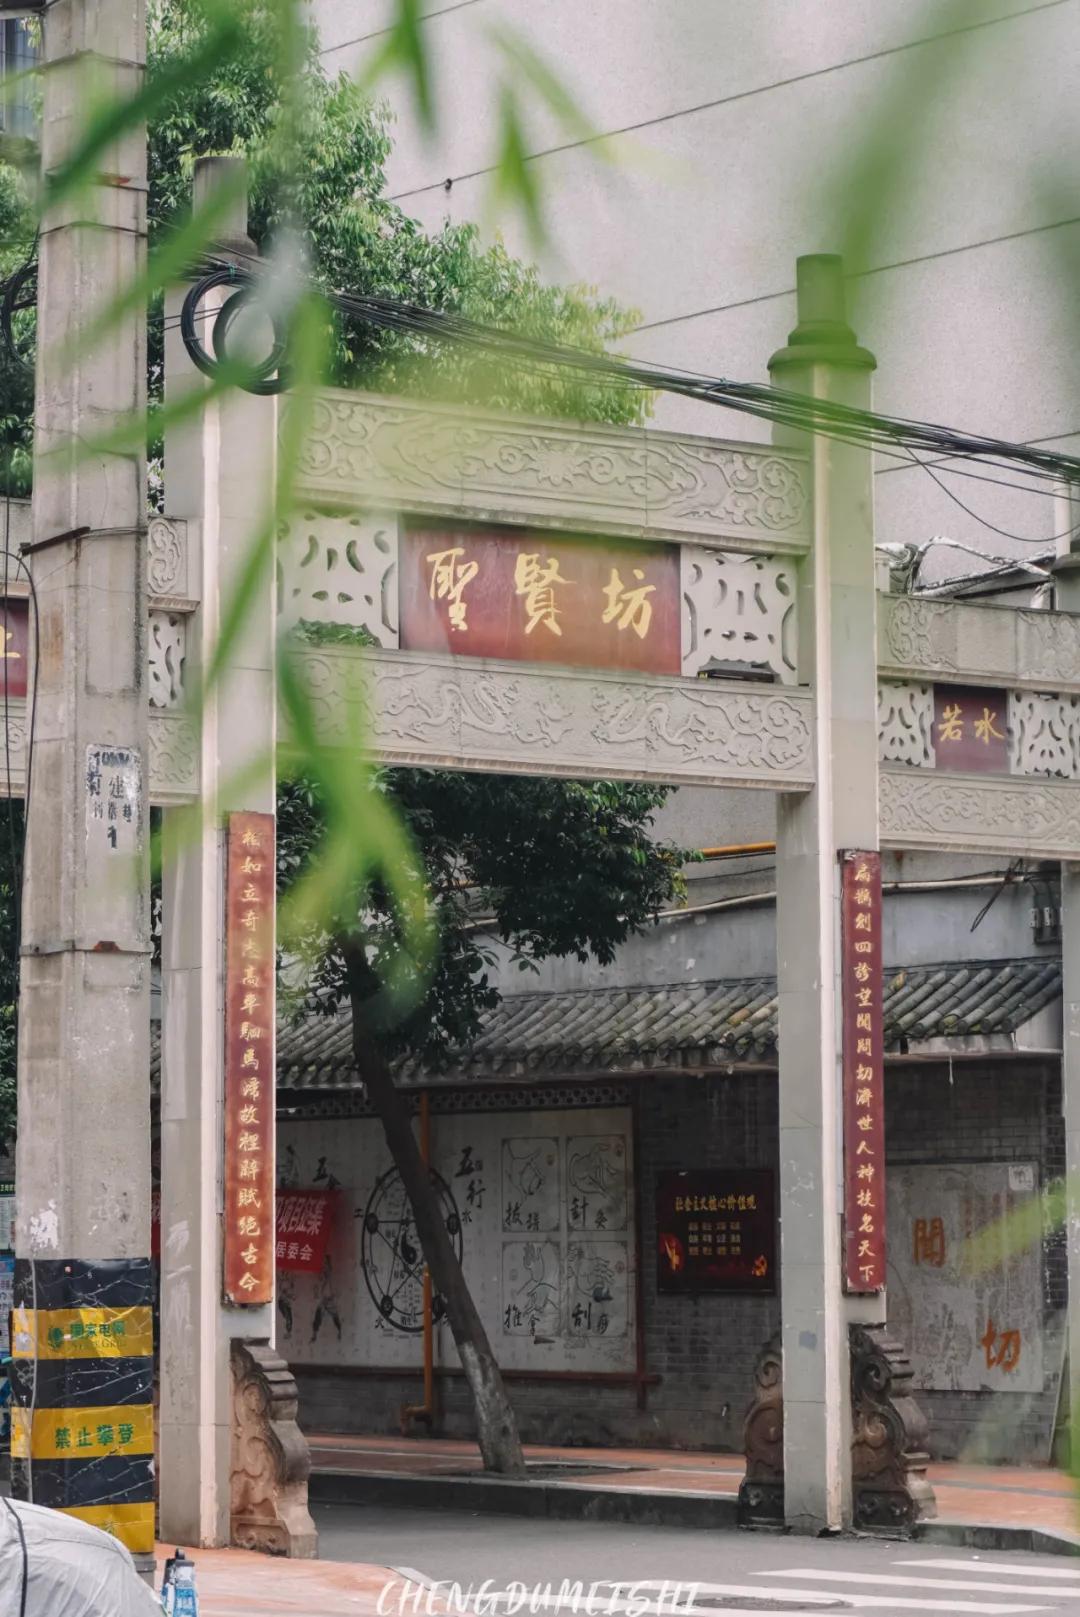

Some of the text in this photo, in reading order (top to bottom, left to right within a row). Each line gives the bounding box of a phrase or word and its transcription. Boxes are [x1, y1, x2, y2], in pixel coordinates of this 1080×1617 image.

[426, 547, 657, 639] 聖賢坊
[938, 703, 1005, 746] 若水
[981, 1318, 1021, 1373] 切
[55, 1423, 134, 1449] 禁止攀登
